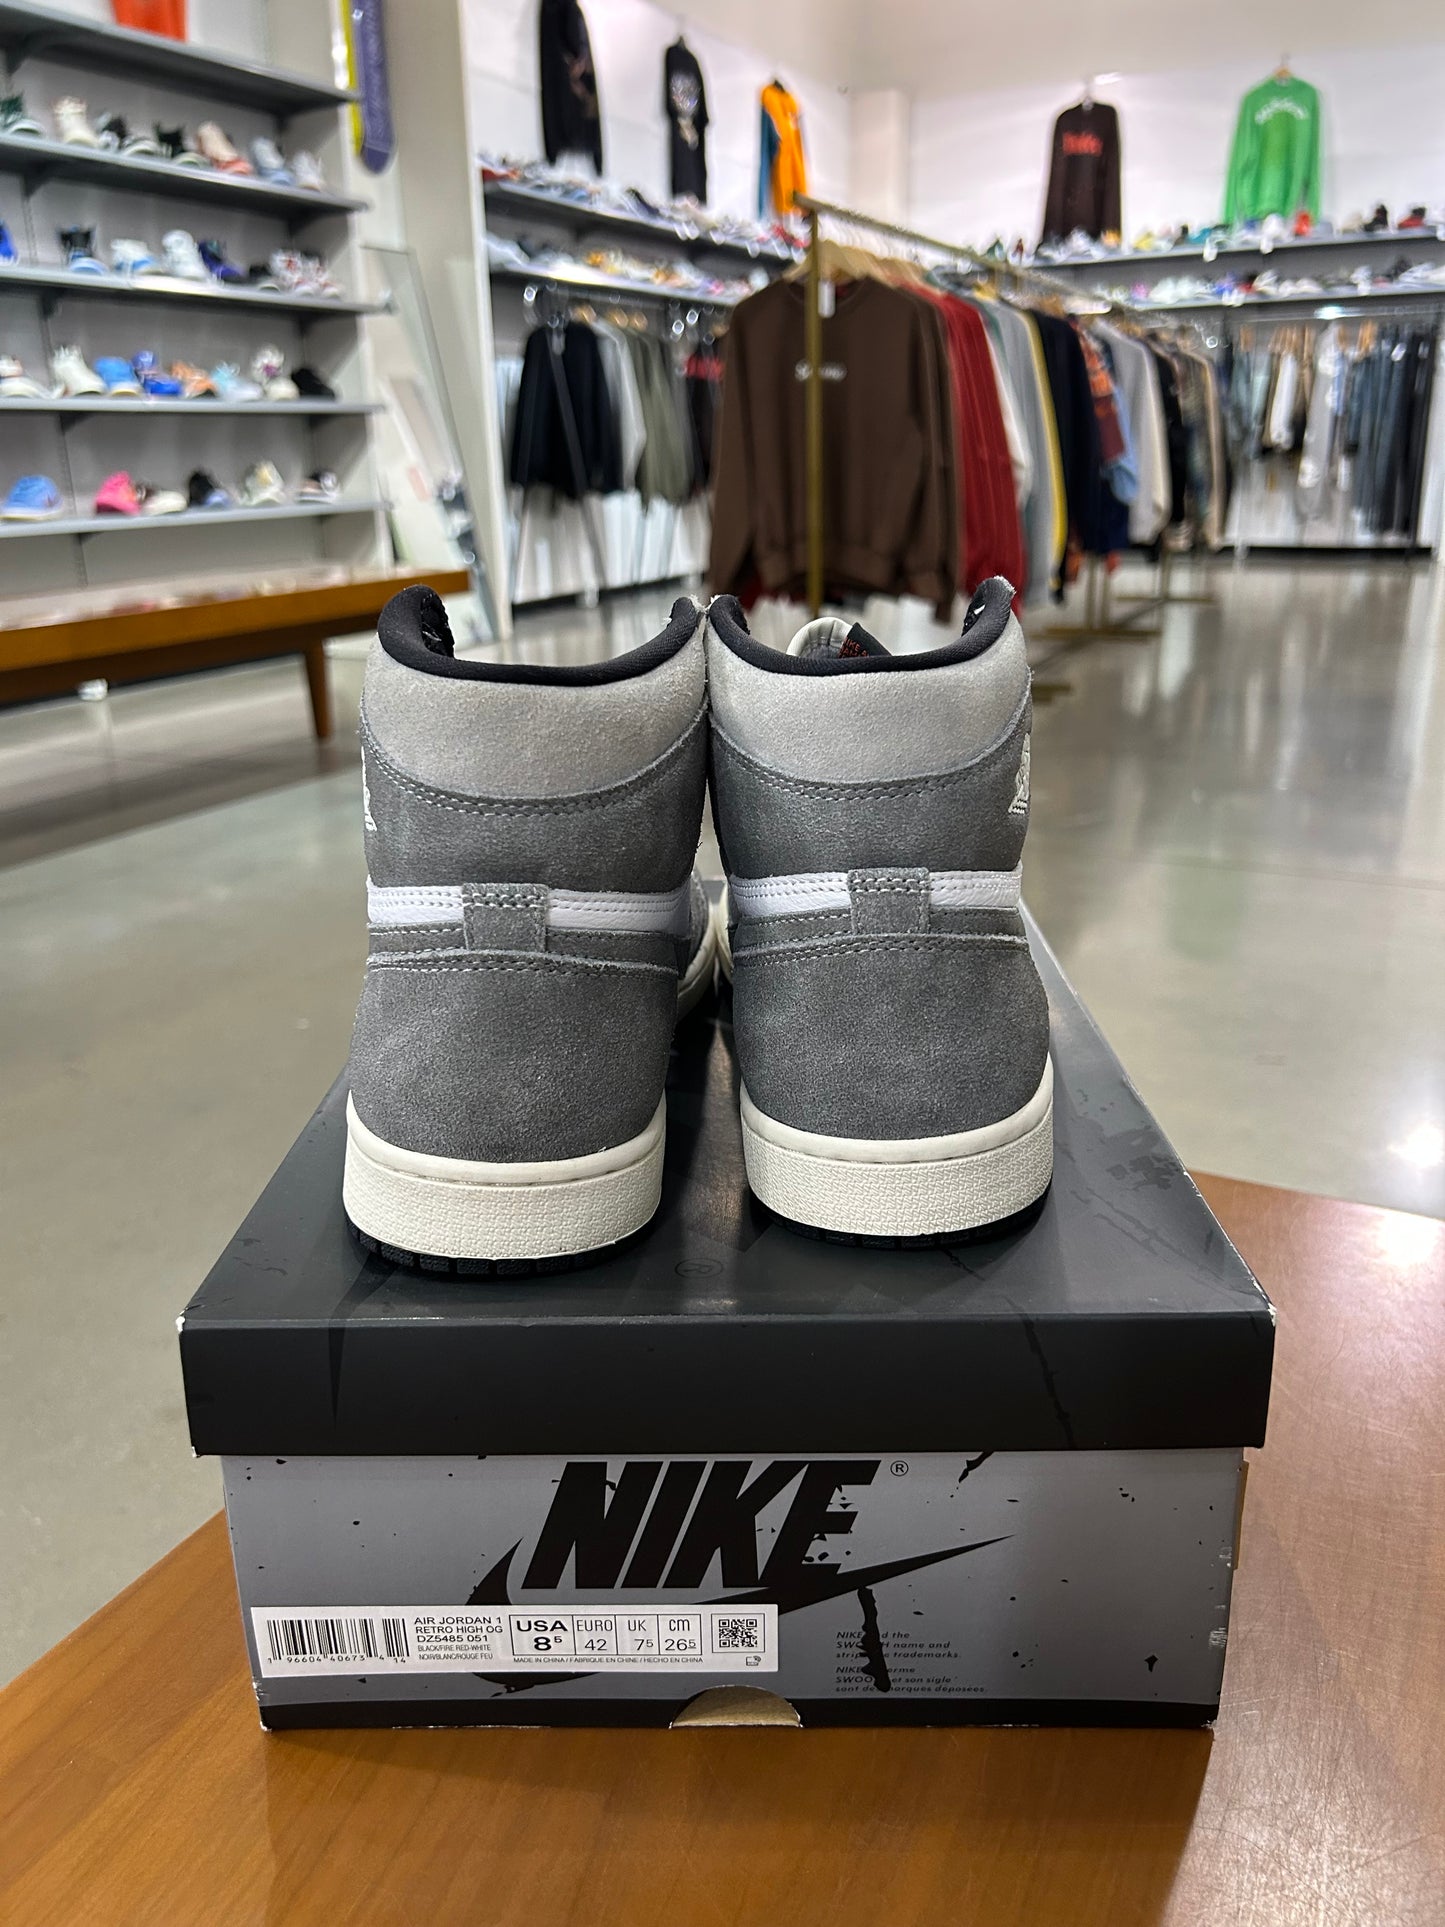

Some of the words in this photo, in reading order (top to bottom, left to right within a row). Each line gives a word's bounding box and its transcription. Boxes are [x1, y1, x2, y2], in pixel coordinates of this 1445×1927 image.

[521, 1460, 881, 1589] NIKE
[414, 1616, 436, 1625] AIR
[439, 1616, 492, 1625] JORDAN
[496, 1616, 501, 1624] 1
[576, 1619, 613, 1632] EURO
[627, 1619, 647, 1632] UK
[415, 1625, 453, 1634] RETRO
[456, 1625, 484, 1634] HIGH
[485, 1625, 503, 1633] OG
[516, 1620, 568, 1632] USA
[417, 1634, 464, 1643] DZ5485
[466, 1634, 489, 1642] 051
[836, 1631, 863, 1639] NIKE
[892, 1631, 910, 1639] the
[584, 1638, 608, 1651] 42
[928, 1640, 951, 1649] and
